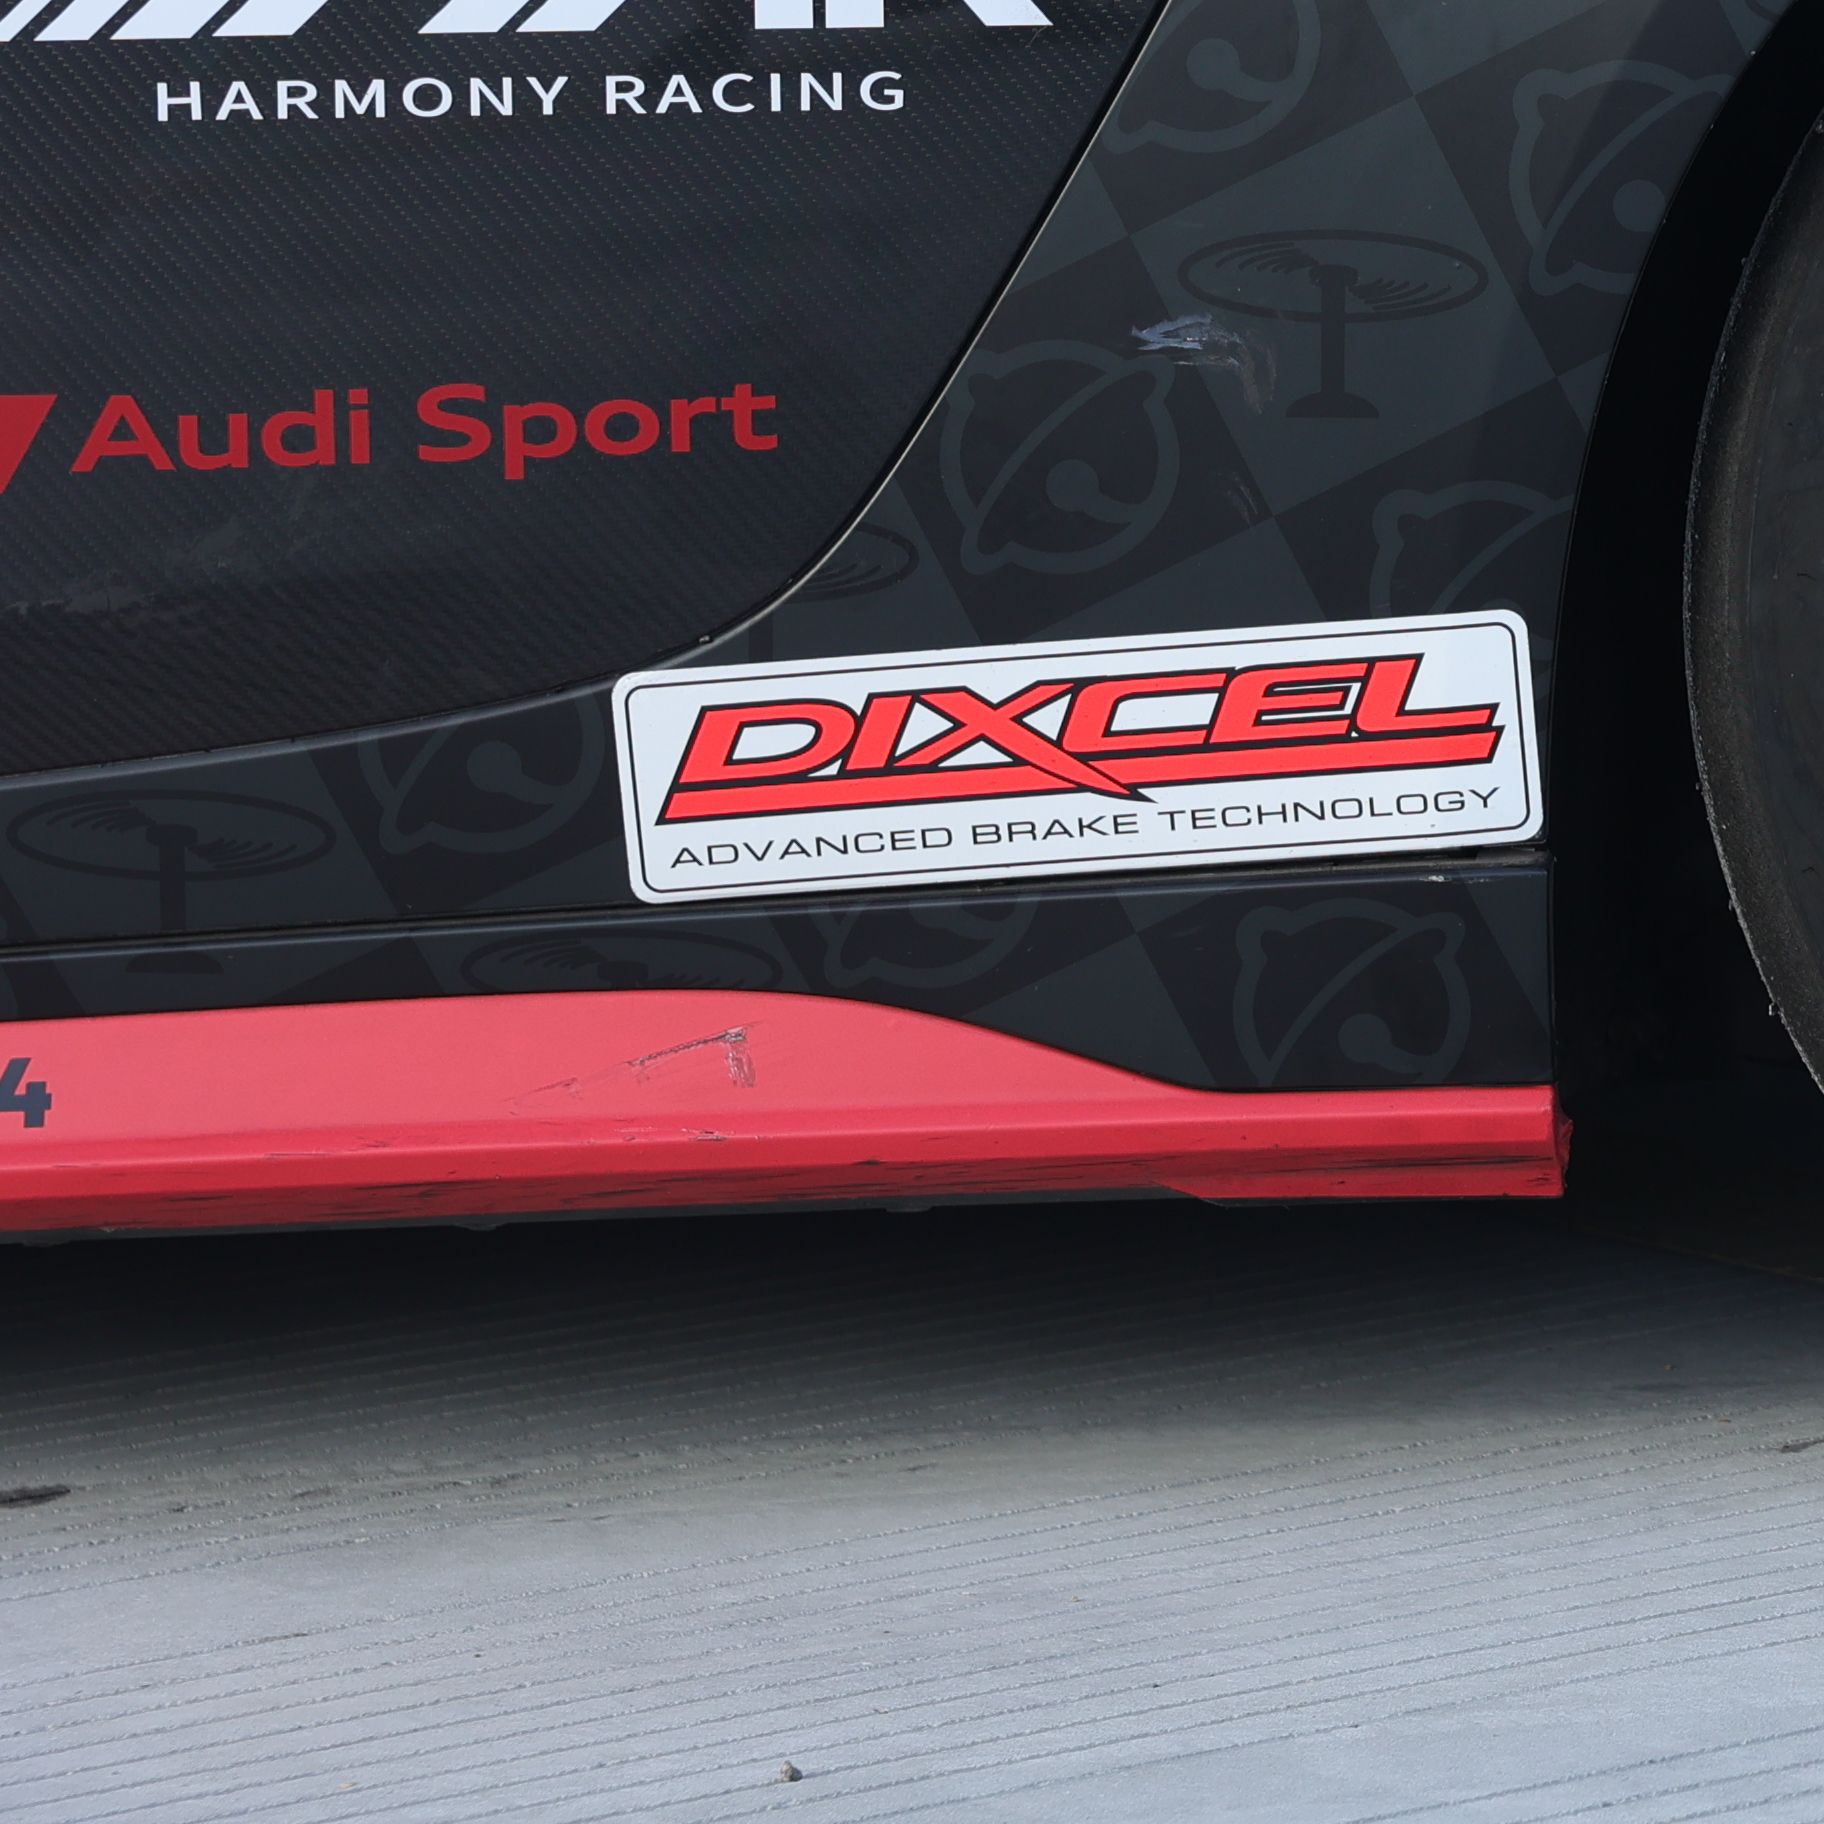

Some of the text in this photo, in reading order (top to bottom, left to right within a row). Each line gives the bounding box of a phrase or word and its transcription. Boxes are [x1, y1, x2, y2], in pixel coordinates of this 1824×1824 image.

[157, 71, 903, 121] HARMONY RACING
[73, 384, 778, 480] Audi Sport
[655, 652, 1504, 825] DIXCEL
[669, 787, 1501, 869] ADVANCED BRAKE TECHNOLOGY
